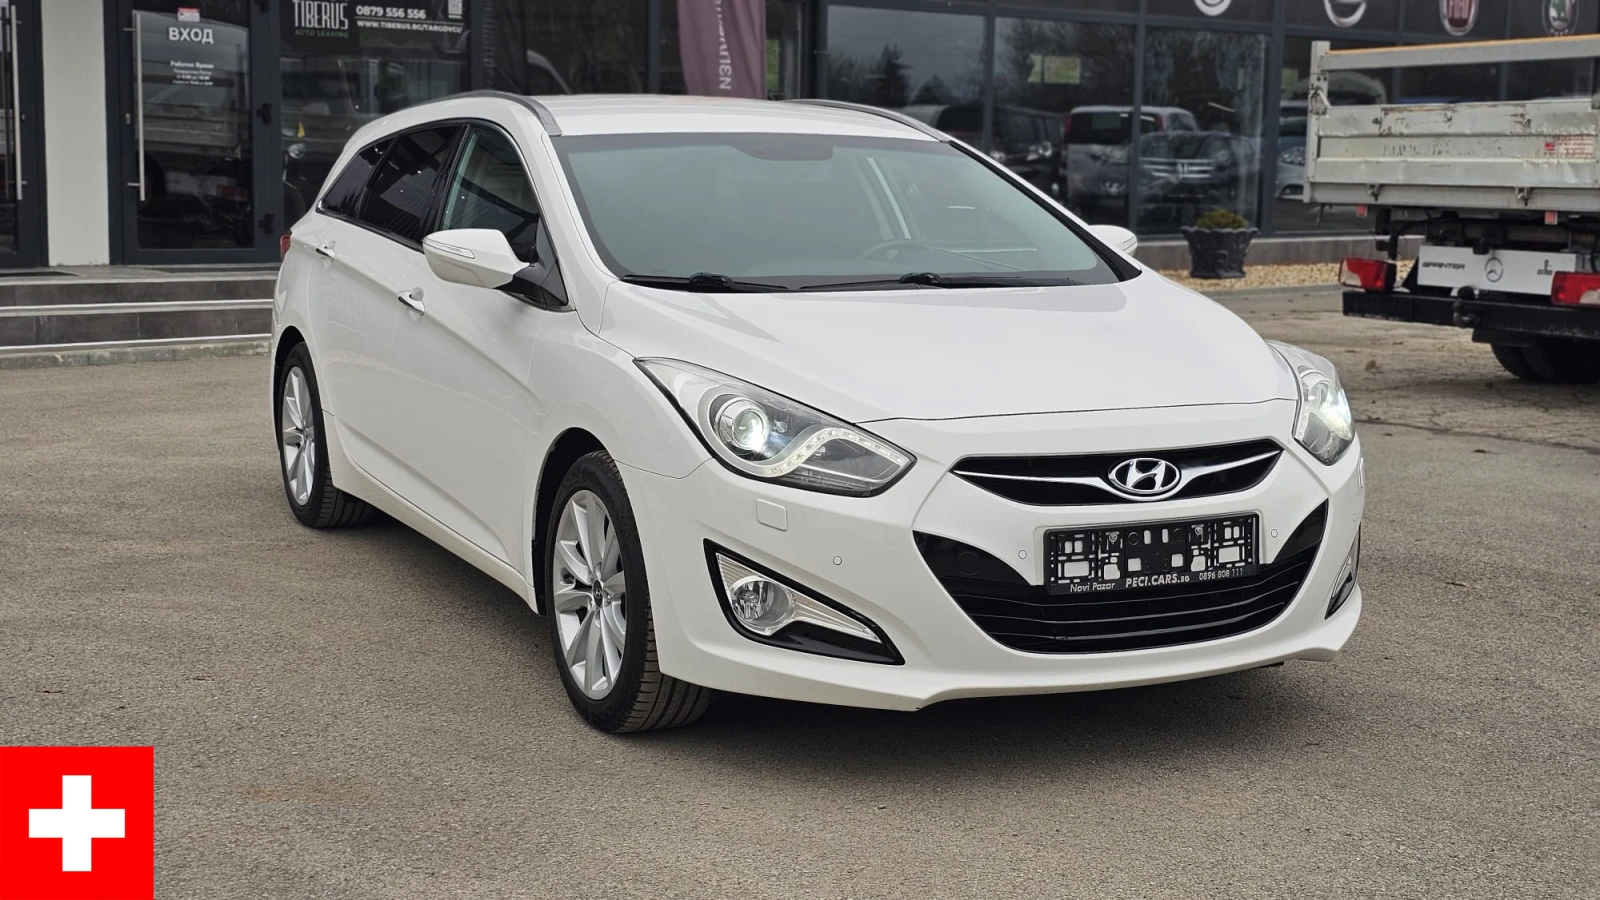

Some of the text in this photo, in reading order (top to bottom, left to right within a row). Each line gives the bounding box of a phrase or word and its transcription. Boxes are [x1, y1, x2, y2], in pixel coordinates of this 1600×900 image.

[292, 0, 349, 30] TIBERUS
[355, 5, 426, 19] 0879 556 556
[169, 27, 214, 45] ВХОД
[295, 29, 349, 39] AUTO LEASING
[1069, 582, 1091, 593] Novi
[1092, 582, 1116, 591] Pazar
[1198, 571, 1216, 581] 0896
[1217, 569, 1230, 579] 808
[1231, 567, 1243, 577] 111
